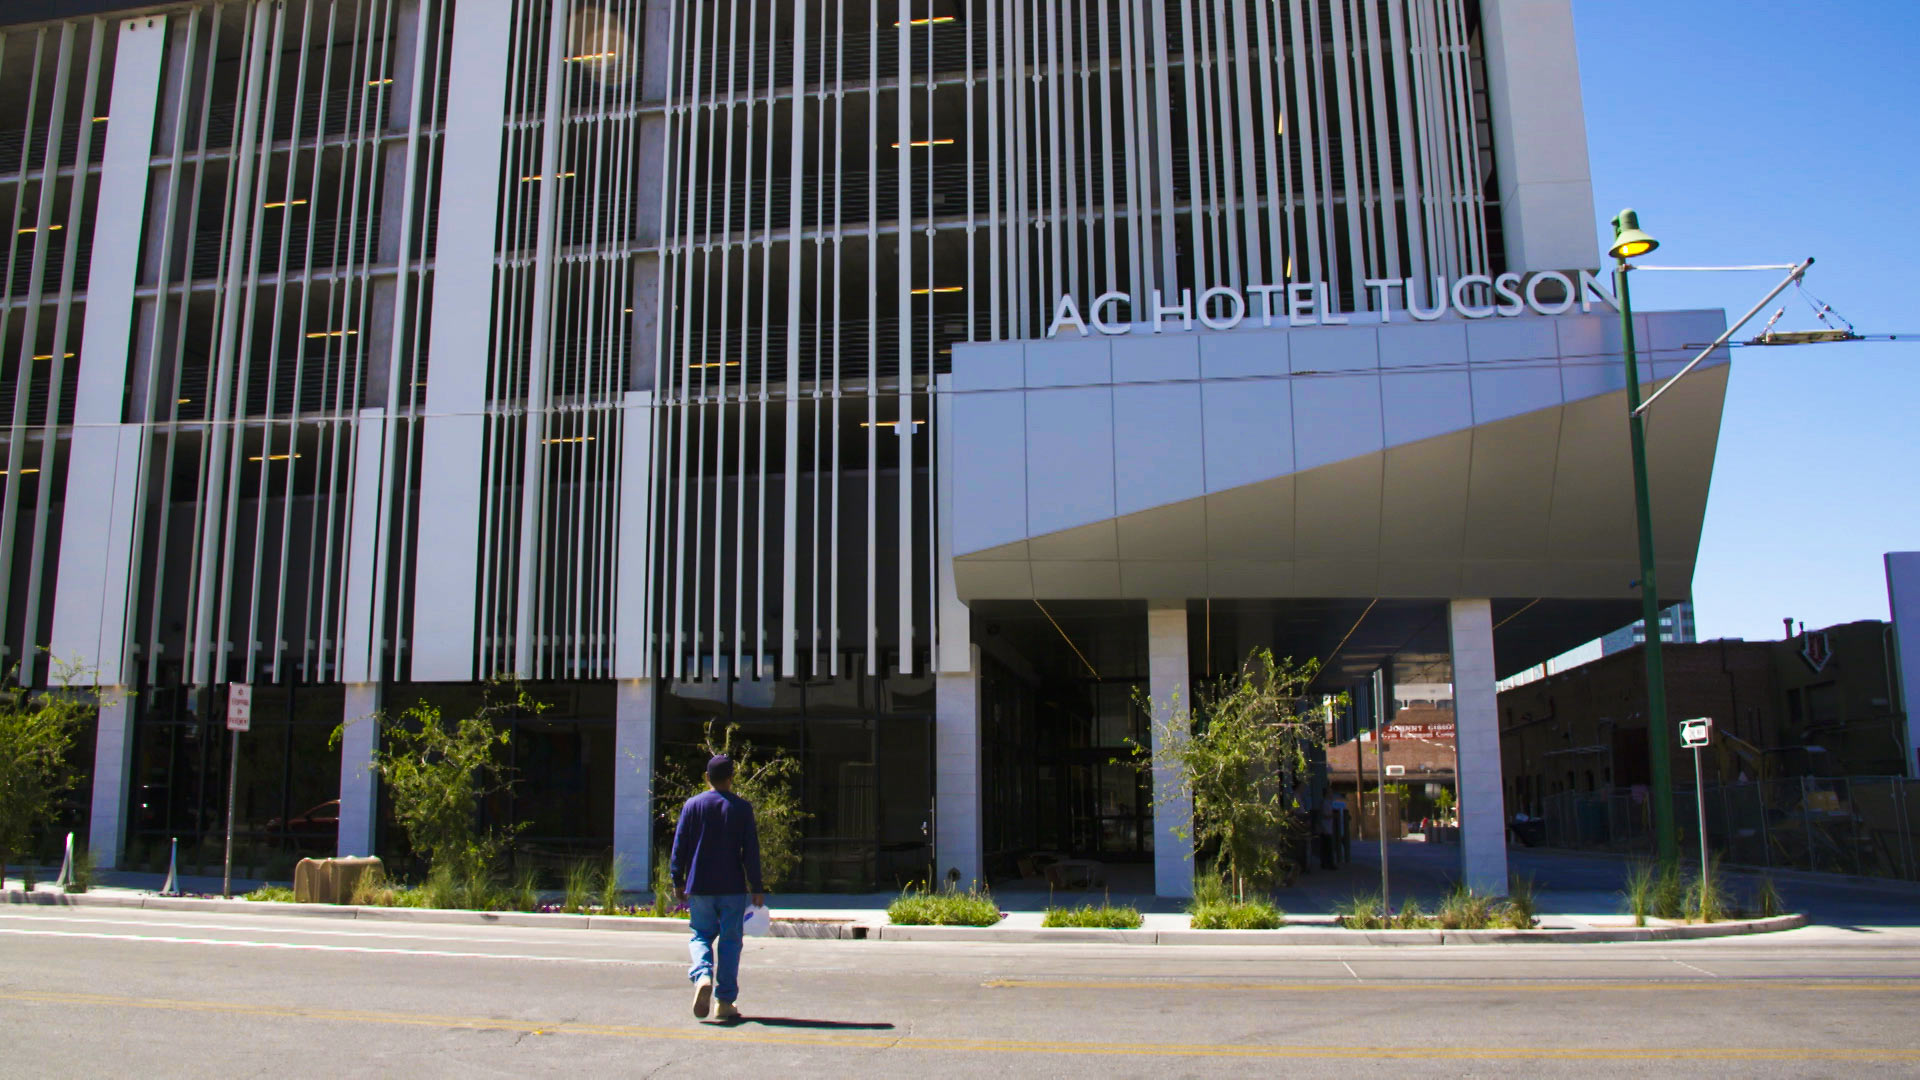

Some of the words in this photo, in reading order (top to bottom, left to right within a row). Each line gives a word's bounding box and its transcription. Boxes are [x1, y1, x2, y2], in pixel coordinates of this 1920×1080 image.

[1047, 290, 1131, 338] AC
[1153, 281, 1349, 333] HOTEL
[1365, 269, 1621, 323] TUCSON
